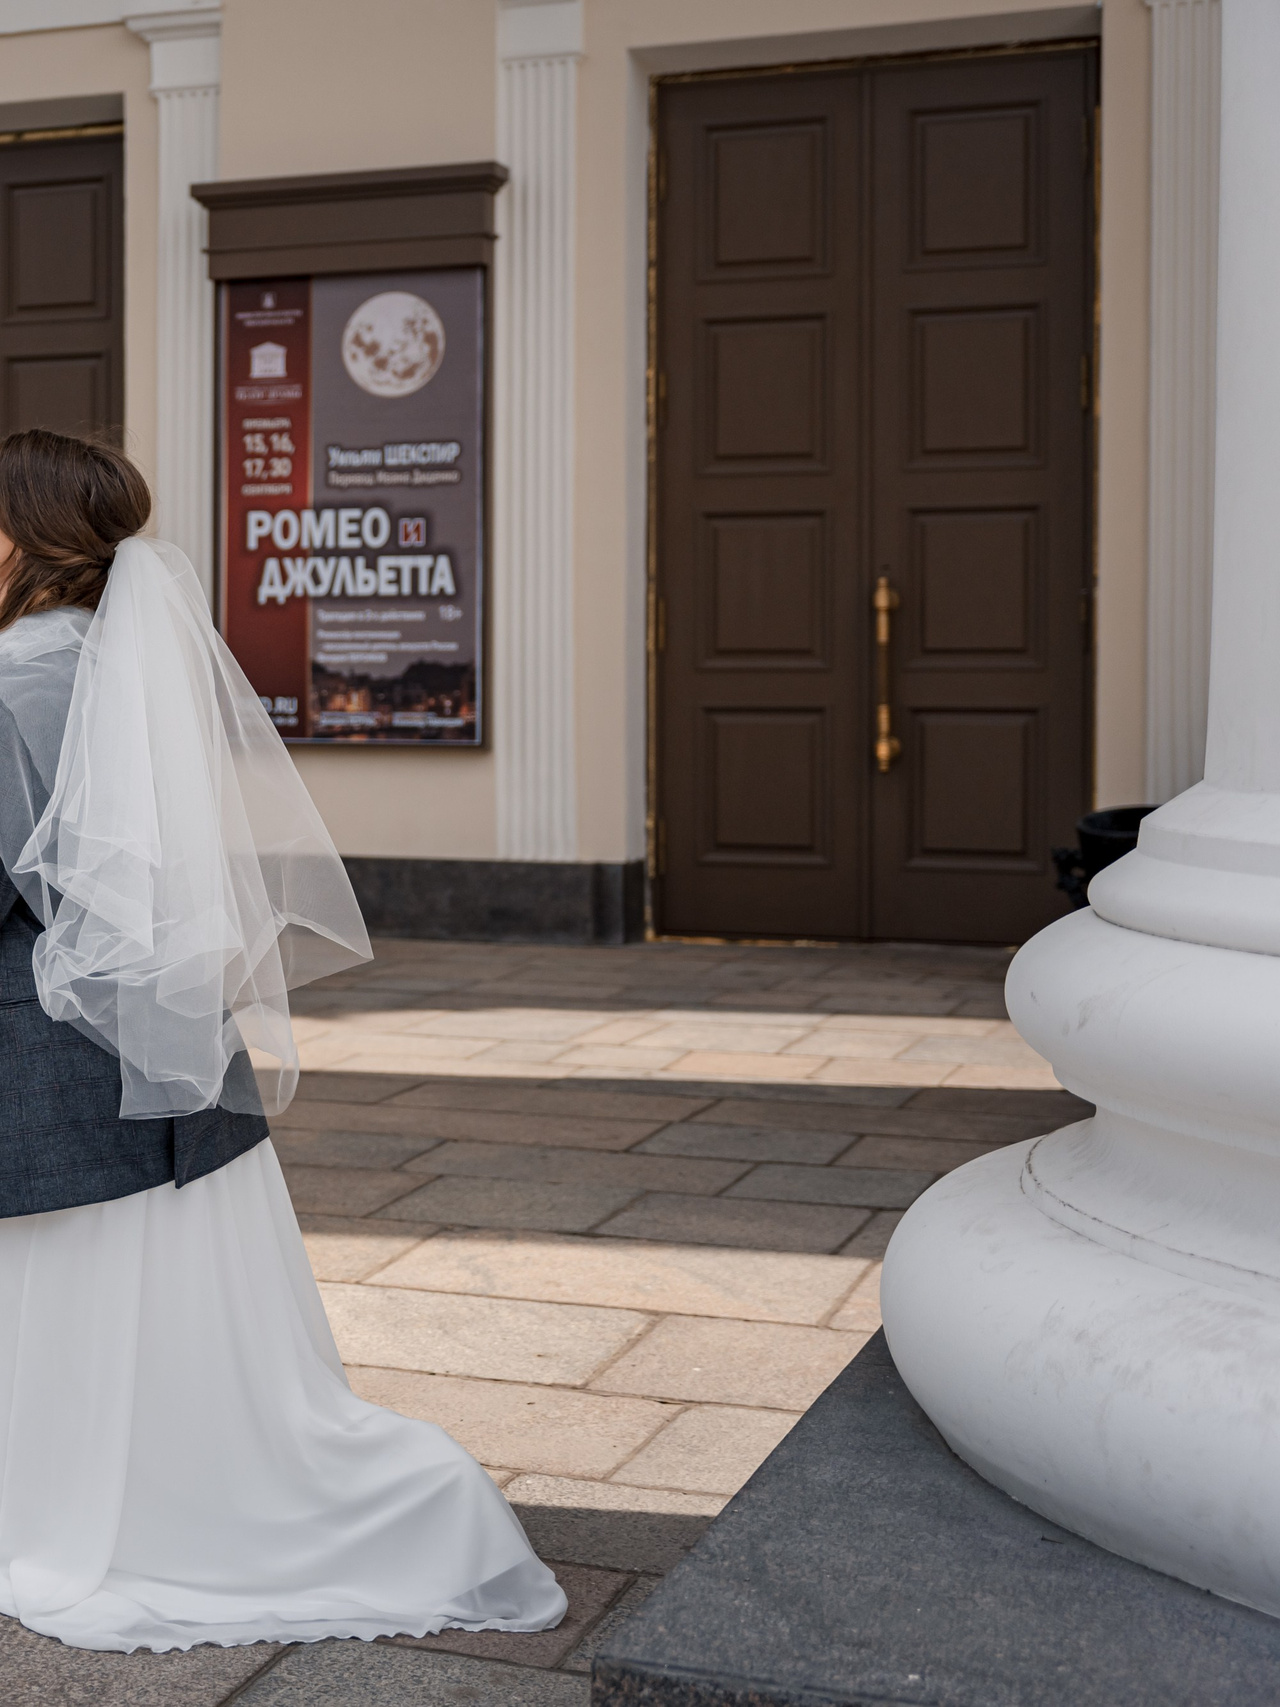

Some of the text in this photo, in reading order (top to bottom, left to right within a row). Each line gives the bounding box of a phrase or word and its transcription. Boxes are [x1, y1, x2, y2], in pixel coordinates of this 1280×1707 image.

[243, 432, 296, 455] 15, 16,
[328, 442, 460, 468] Уильям ШЕКСПИР
[243, 457, 292, 480] 17, 30
[247, 507, 427, 550] РОМЕО И
[257, 555, 456, 604] ДЖУЛЬЕТТА
